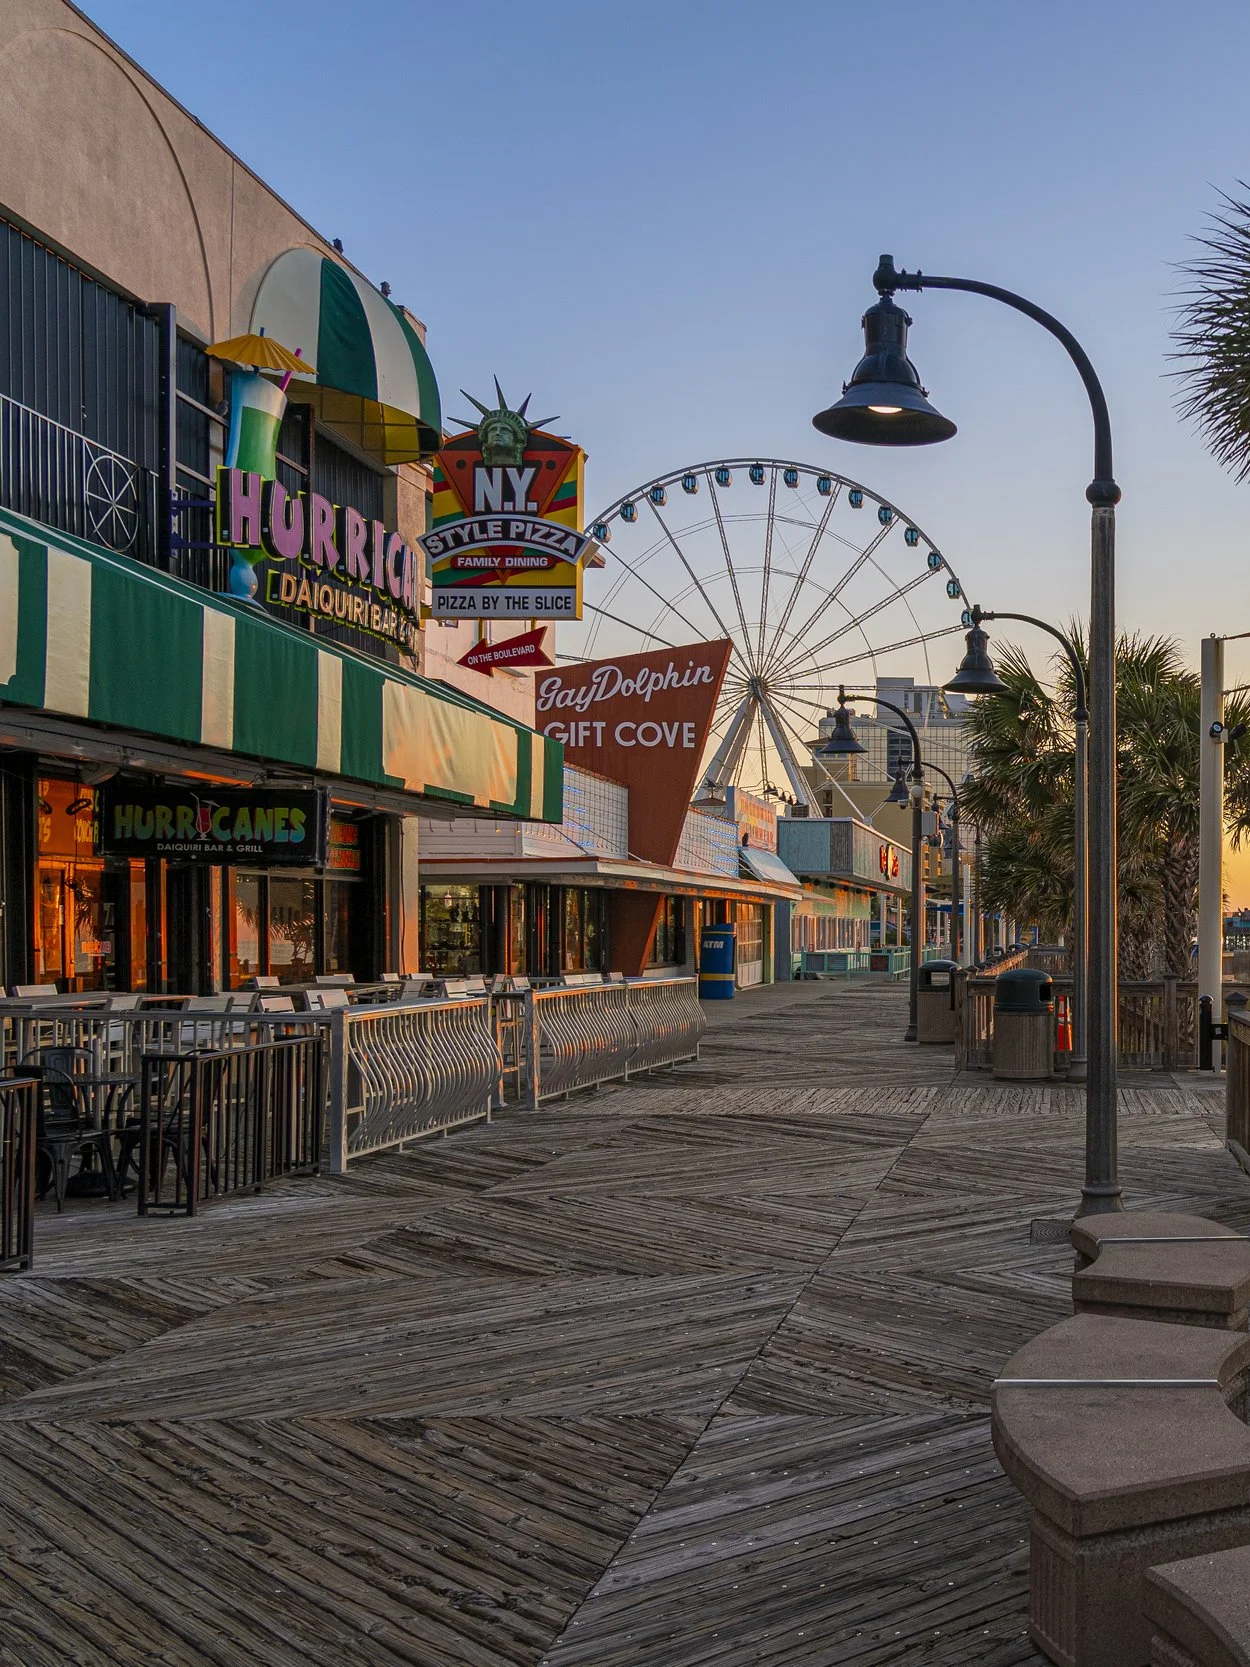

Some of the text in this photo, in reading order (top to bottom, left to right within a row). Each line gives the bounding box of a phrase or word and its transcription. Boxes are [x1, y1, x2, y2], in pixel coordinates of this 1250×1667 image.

[475, 468, 538, 512] N.Y.
[425, 521, 577, 556] STYLE PIZZA
[457, 557, 548, 567] FAMILY DINING
[280, 572, 369, 627] DAIQUIRI
[437, 595, 572, 611] PIZZA BY THE SLICE
[467, 644, 536, 665] ON THE BOULEVARD
[543, 721, 696, 748] GIFT COVE
[157, 843, 263, 854] DAIQUIRI BAR & GRILL
[702, 940, 724, 950] ATM
